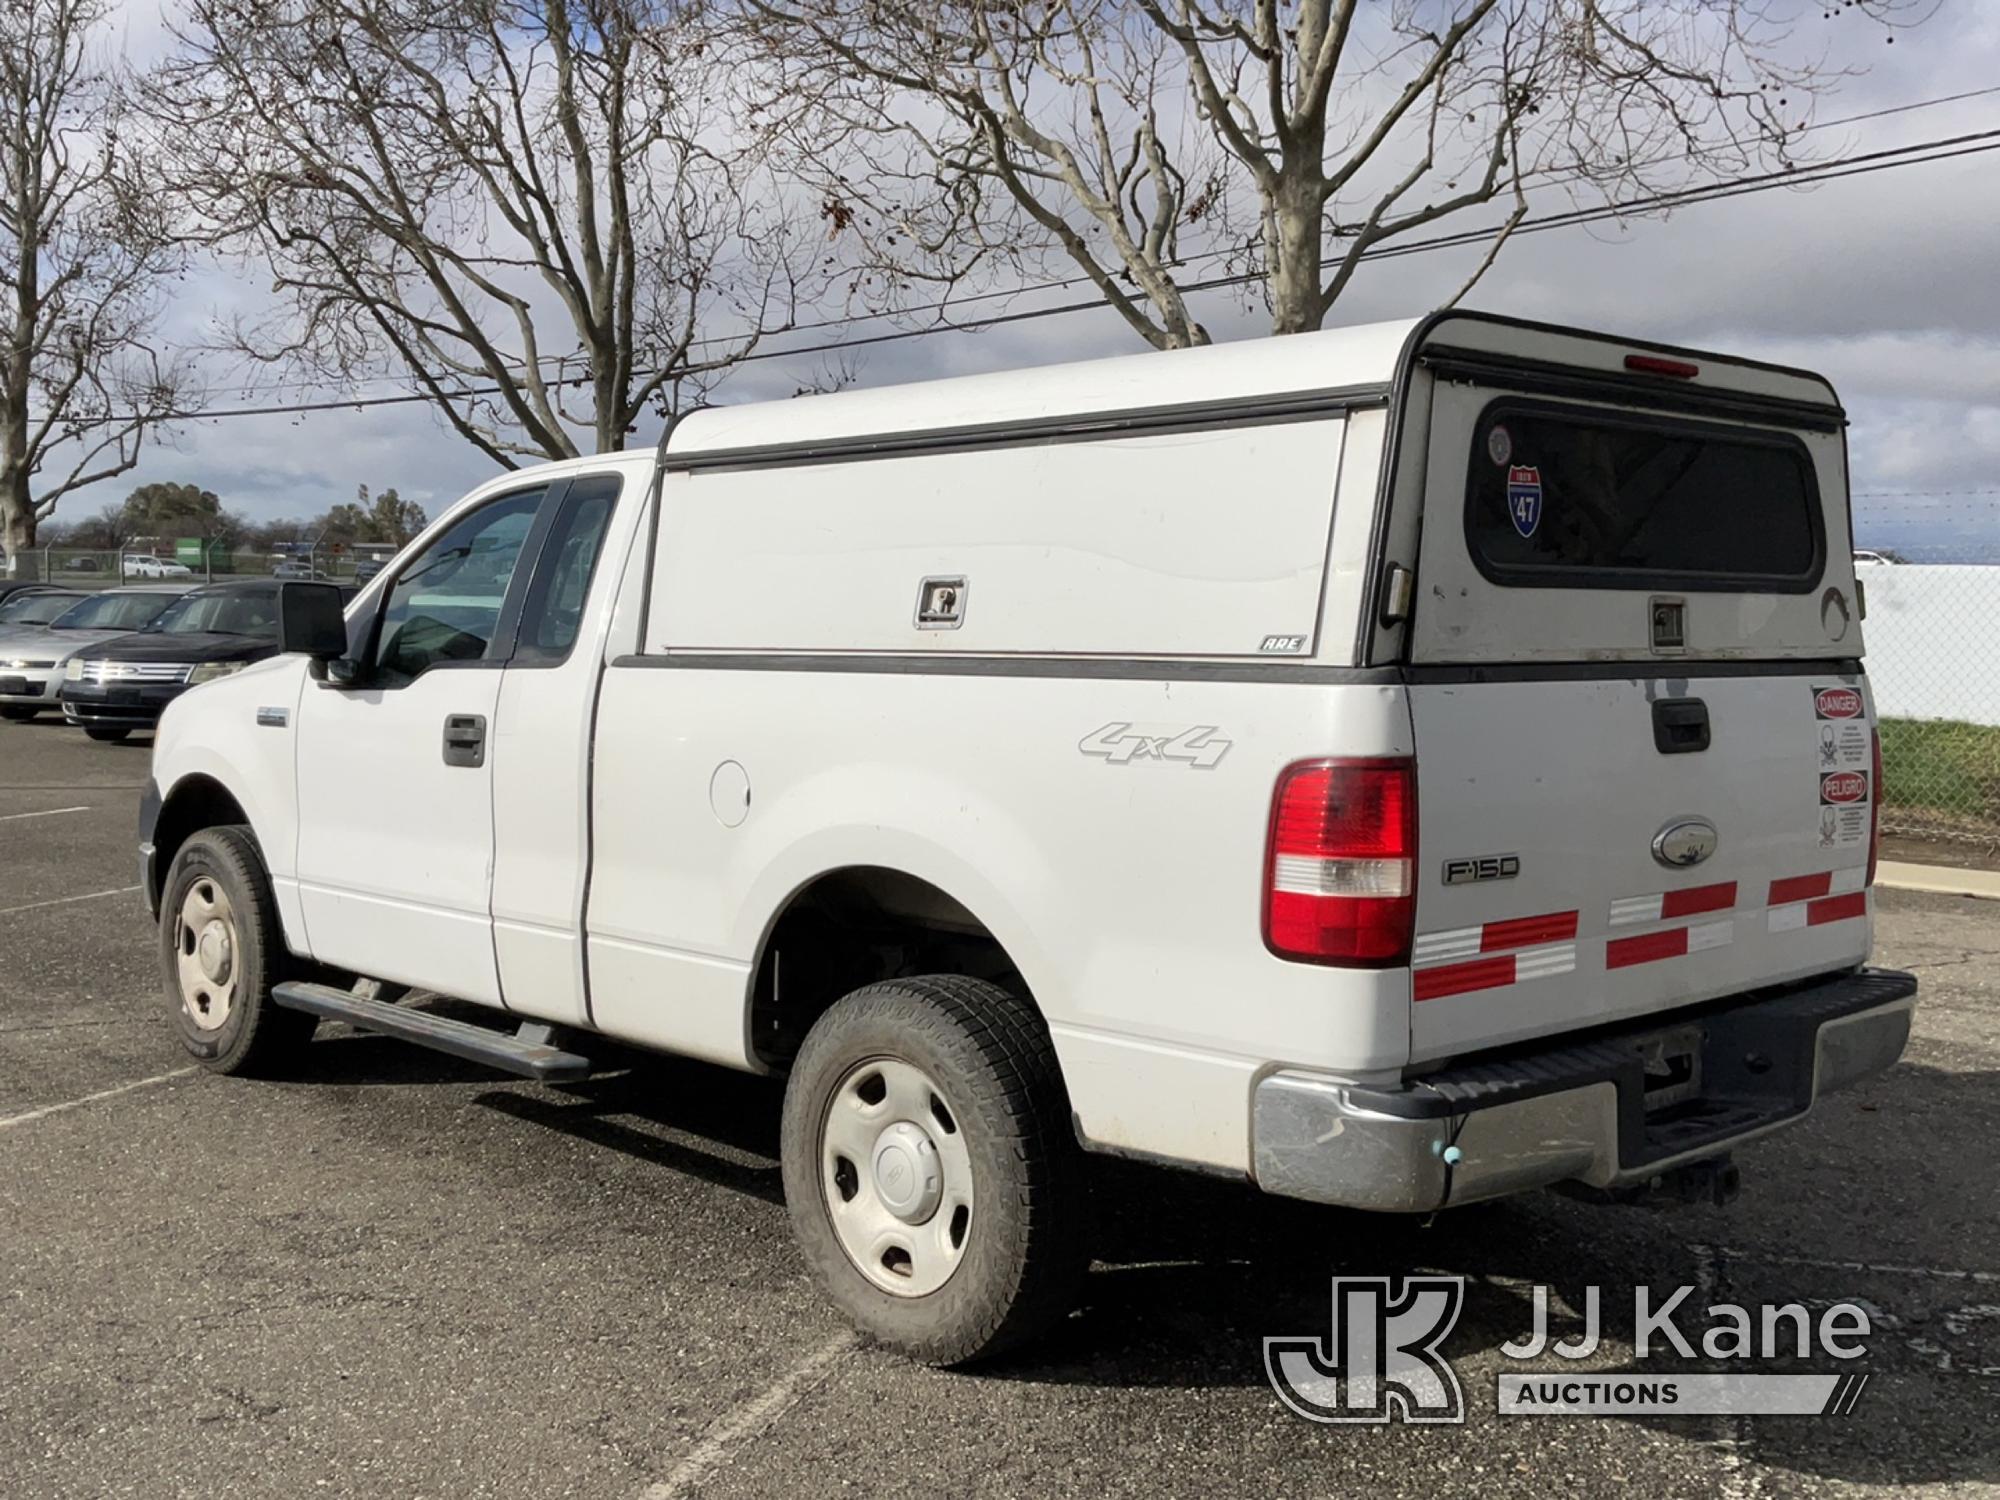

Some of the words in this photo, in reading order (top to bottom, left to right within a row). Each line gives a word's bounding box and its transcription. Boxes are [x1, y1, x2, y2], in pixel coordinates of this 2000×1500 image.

[1262, 636, 1301, 651] ARE
[1819, 695, 1858, 712] DANGER
[1078, 721, 1233, 769] 4x4
[1825, 778, 1863, 796] PELIGRO
[1446, 856, 1520, 882] F-150
